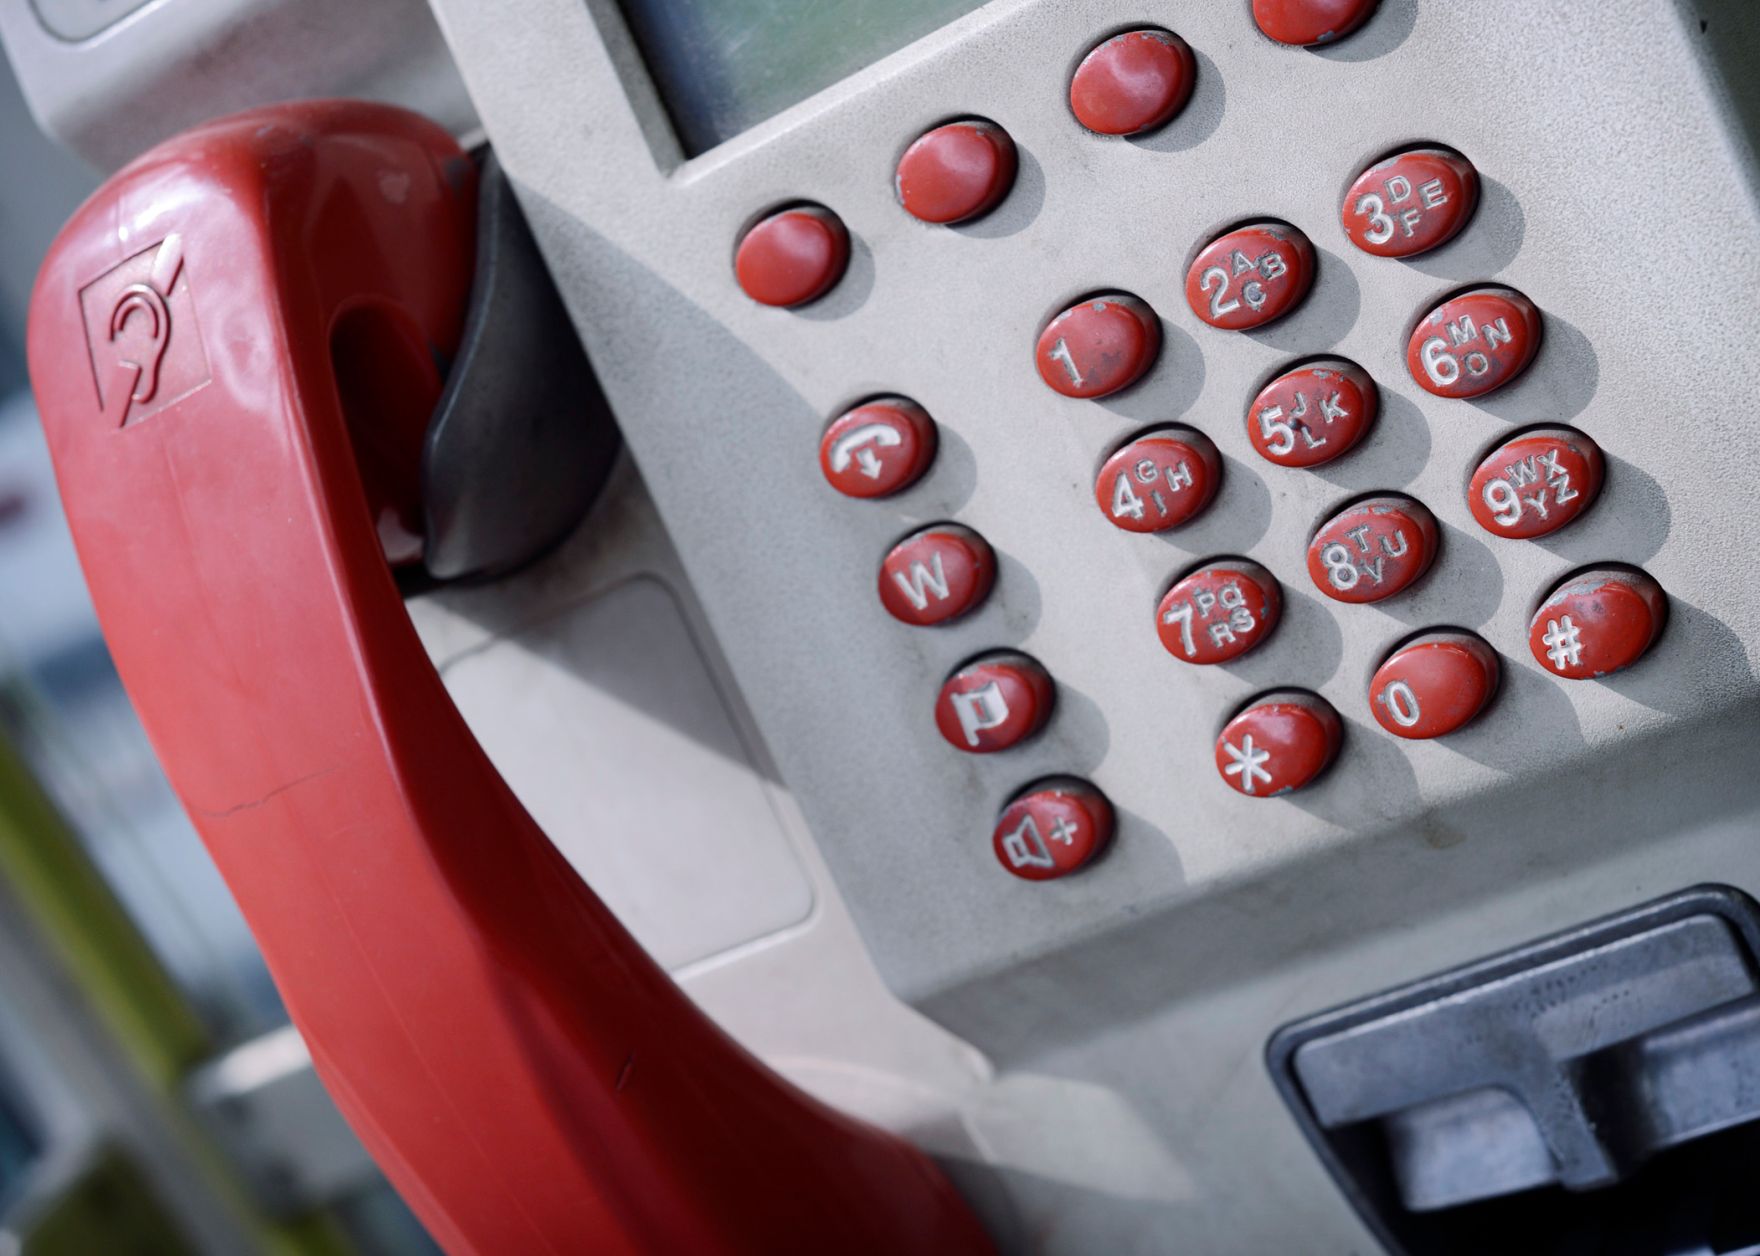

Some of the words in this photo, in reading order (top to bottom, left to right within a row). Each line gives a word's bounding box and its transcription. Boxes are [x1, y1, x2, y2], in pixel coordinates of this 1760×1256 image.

[1355, 193, 1395, 244] 3
[1200, 266, 1240, 319] 2
[1049, 338, 1084, 388] 1
[1420, 335, 1460, 386] 6
[1258, 405, 1294, 456] 5
[1111, 471, 1145, 519] 4
[1481, 479, 1523, 527] 9
[893, 551, 950, 611] W
[1320, 542, 1359, 591] 8
[1163, 601, 1198, 657] 7
[1542, 614, 1585, 669] #
